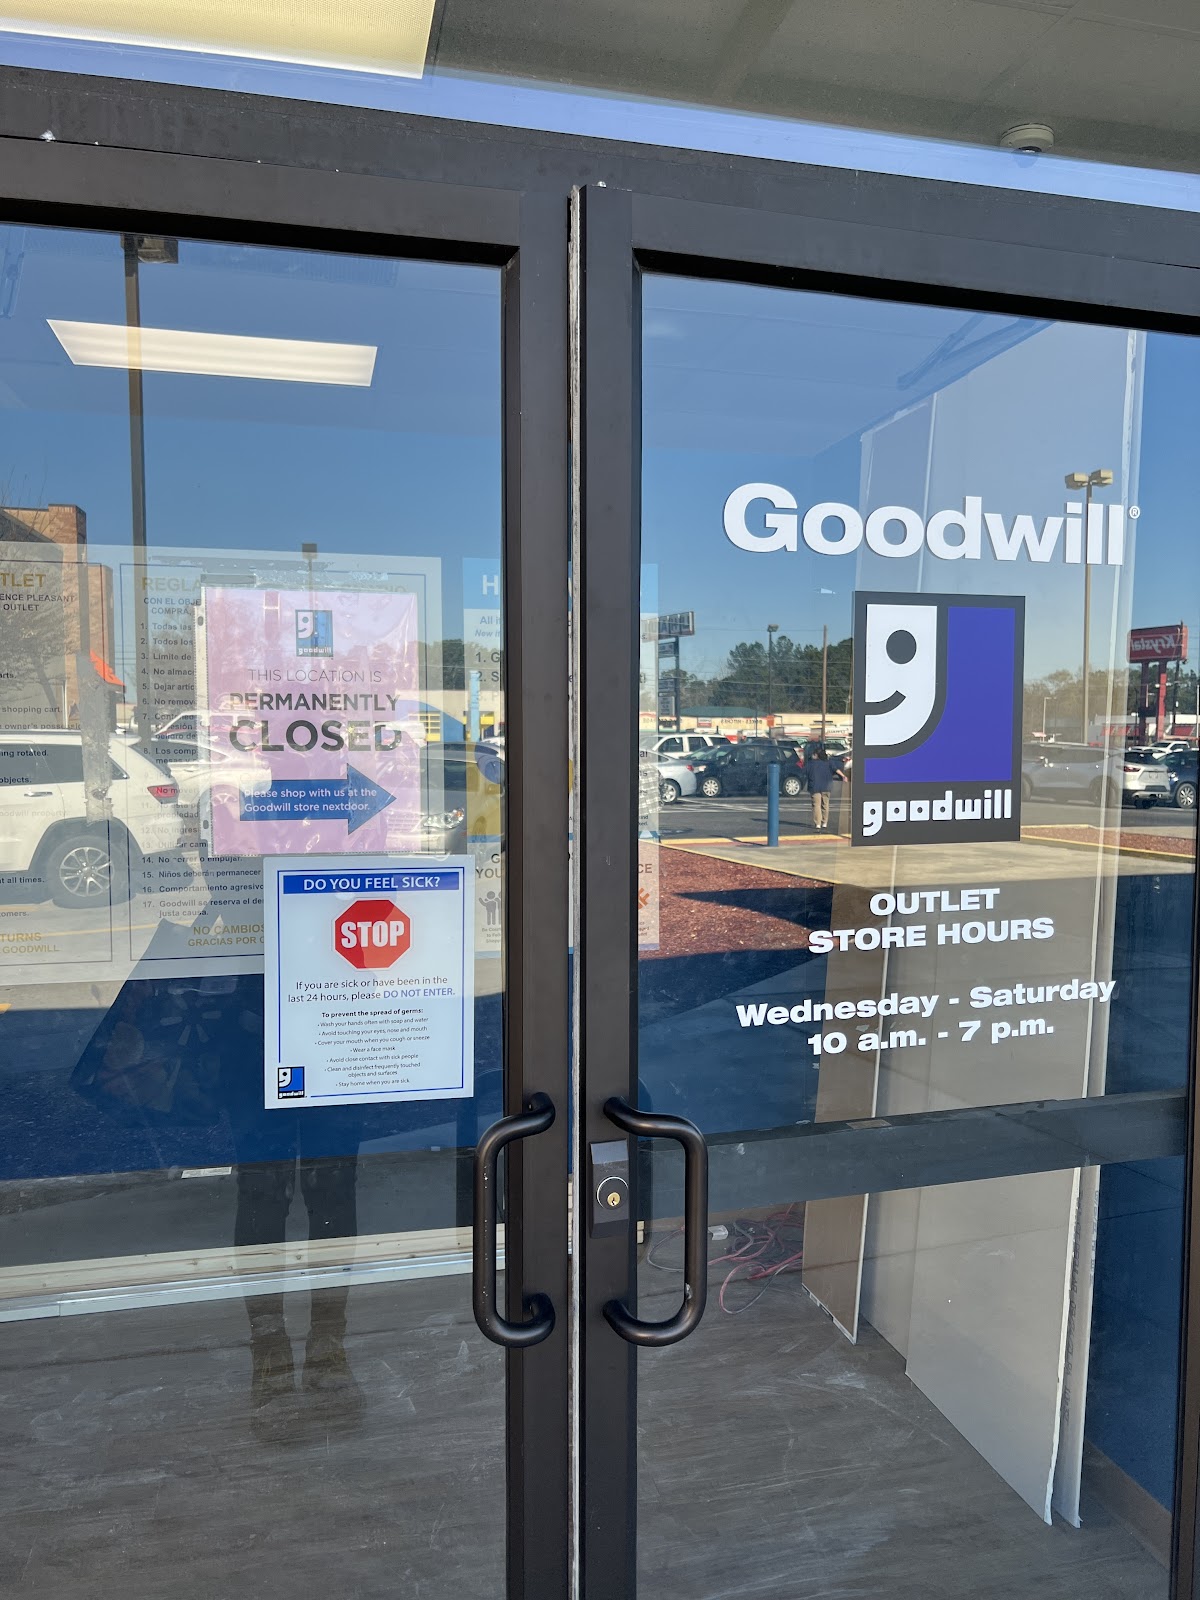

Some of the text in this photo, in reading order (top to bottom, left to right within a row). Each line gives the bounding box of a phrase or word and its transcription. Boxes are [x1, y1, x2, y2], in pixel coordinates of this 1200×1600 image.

[27, 594, 75, 602] PLEASANT
[143, 597, 163, 605] CON
[165, 597, 176, 605] EL
[3, 603, 39, 611] OUTLET
[140, 622, 148, 630] 1.
[152, 623, 178, 631] Todas
[140, 637, 193, 646] 2. Todos los
[141, 652, 149, 660] 3.
[181, 653, 192, 661] de
[298, 647, 332, 656] goodwill
[248, 669, 382, 683] THIS LOCATION IS
[153, 683, 176, 692] Dejar
[229, 693, 401, 711] PERMANENTLY
[2, 706, 42, 715] shopping
[229, 719, 402, 752] CLOSED
[155, 747, 171, 755] Los
[244, 788, 278, 798] Please
[280, 788, 306, 799] shop
[308, 788, 331, 797] with
[347, 788, 358, 797] at
[360, 787, 377, 797] the
[244, 802, 370, 812] Goodwill store nextdoor.
[862, 788, 1013, 838] goodwill
[142, 871, 154, 879] 15.
[216, 869, 261, 878] permanecer
[19, 876, 45, 884] times.
[303, 876, 441, 891] DO YOU FEEL SICK?
[159, 884, 228, 893] Comportamiento
[159, 899, 196, 908] Goodwill
[210, 898, 241, 906] reserva
[242, 897, 250, 905] el
[869, 888, 1000, 916] OUTLET
[158, 911, 180, 919] justa
[193, 926, 210, 935] NO
[340, 920, 405, 949] STOP
[808, 917, 1055, 954] STORE HOURS
[187, 936, 257, 947] GRACIAS POR
[2, 944, 61, 954] GOODWILL
[296, 981, 303, 990] If
[304, 983, 322, 992] you
[324, 981, 339, 989] are
[341, 979, 359, 989] sick
[372, 979, 395, 987] have
[397, 977, 420, 986] been
[422, 976, 431, 985] in
[433, 976, 448, 984] the
[288, 987, 456, 1003] last 24 hours, please DO NOT ENTER.
[736, 992, 940, 1029] Wednesday
[969, 978, 1118, 1010] Saturday
[330, 1011, 357, 1019] prevent
[807, 1032, 847, 1056] 10
[857, 1028, 926, 1052] a.m.
[958, 1020, 982, 1042] 7
[991, 1017, 1055, 1044] p.m.
